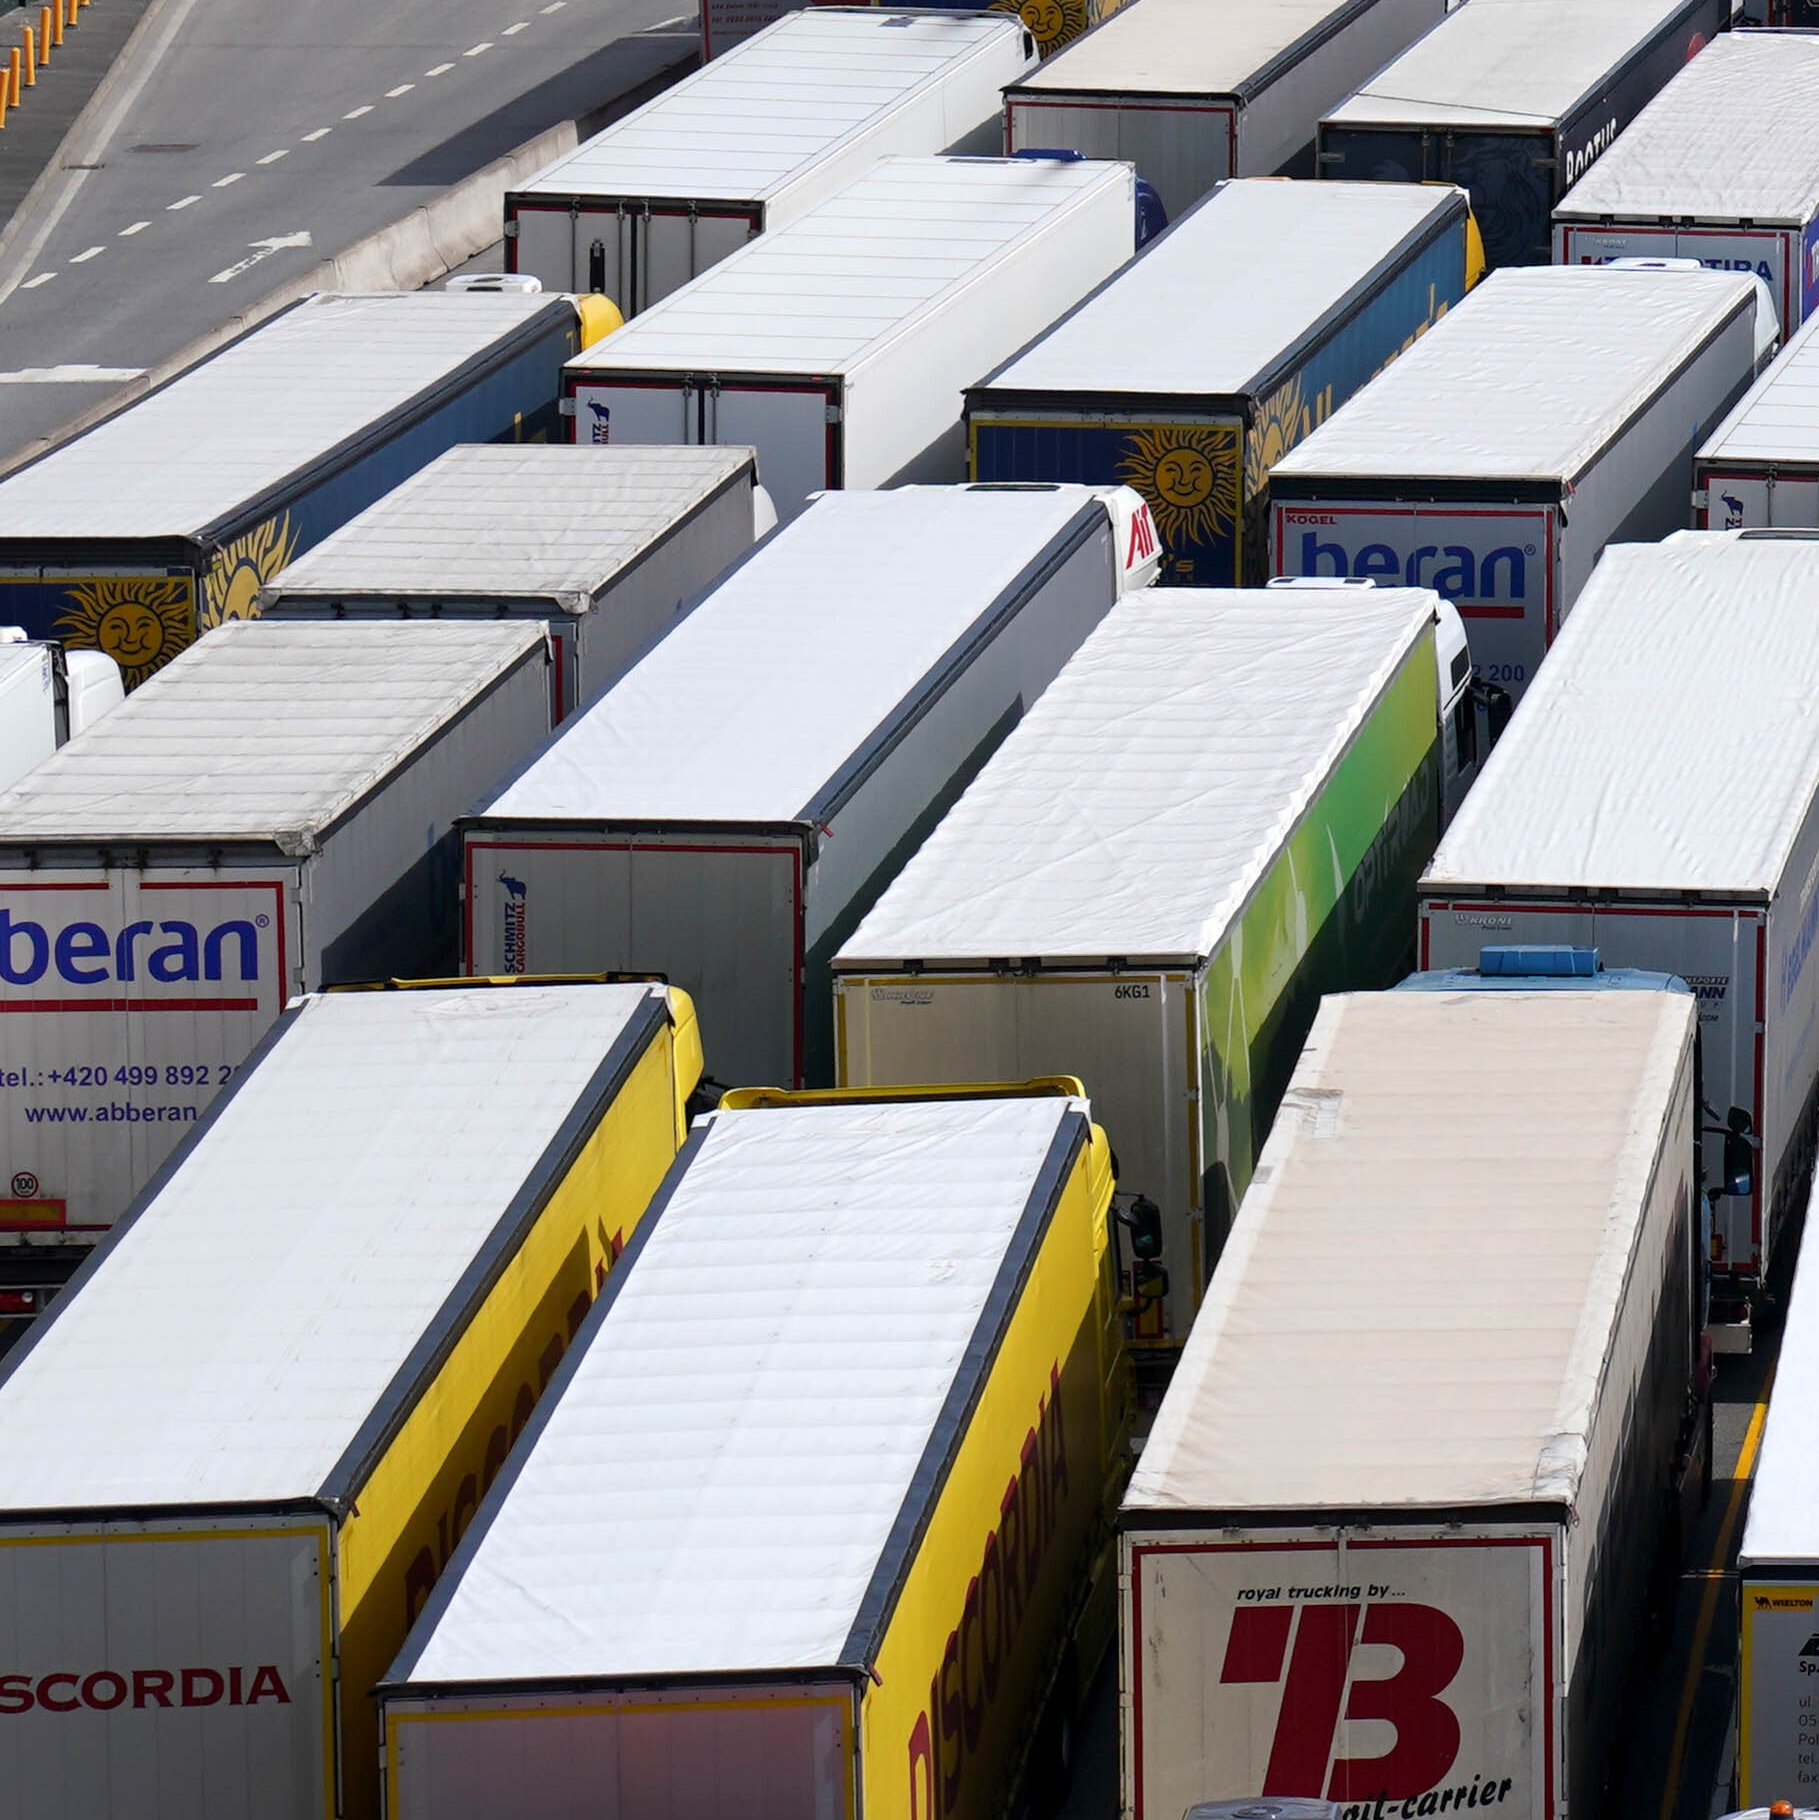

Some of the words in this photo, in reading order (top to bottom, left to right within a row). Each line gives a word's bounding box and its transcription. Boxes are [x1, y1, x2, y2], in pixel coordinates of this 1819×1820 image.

[1488, 664, 1525, 681] 200
[504, 901, 515, 974] SCHMITZ
[515, 902, 526, 974] CARGOBULL
[1114, 985, 1151, 1000] 6KG1
[113, 1065, 158, 1086] 499
[165, 1064, 209, 1086] 892
[16, 1177, 35, 1190] 100
[1237, 1585, 1280, 1603] royal
[1288, 1583, 1360, 1602] trucking
[1772, 1598, 1813, 1607] WIELTON
[1799, 1660, 1819, 1676] Sp.
[1799, 1752, 1817, 1765] tel.
[1799, 1771, 1818, 1784] fax
